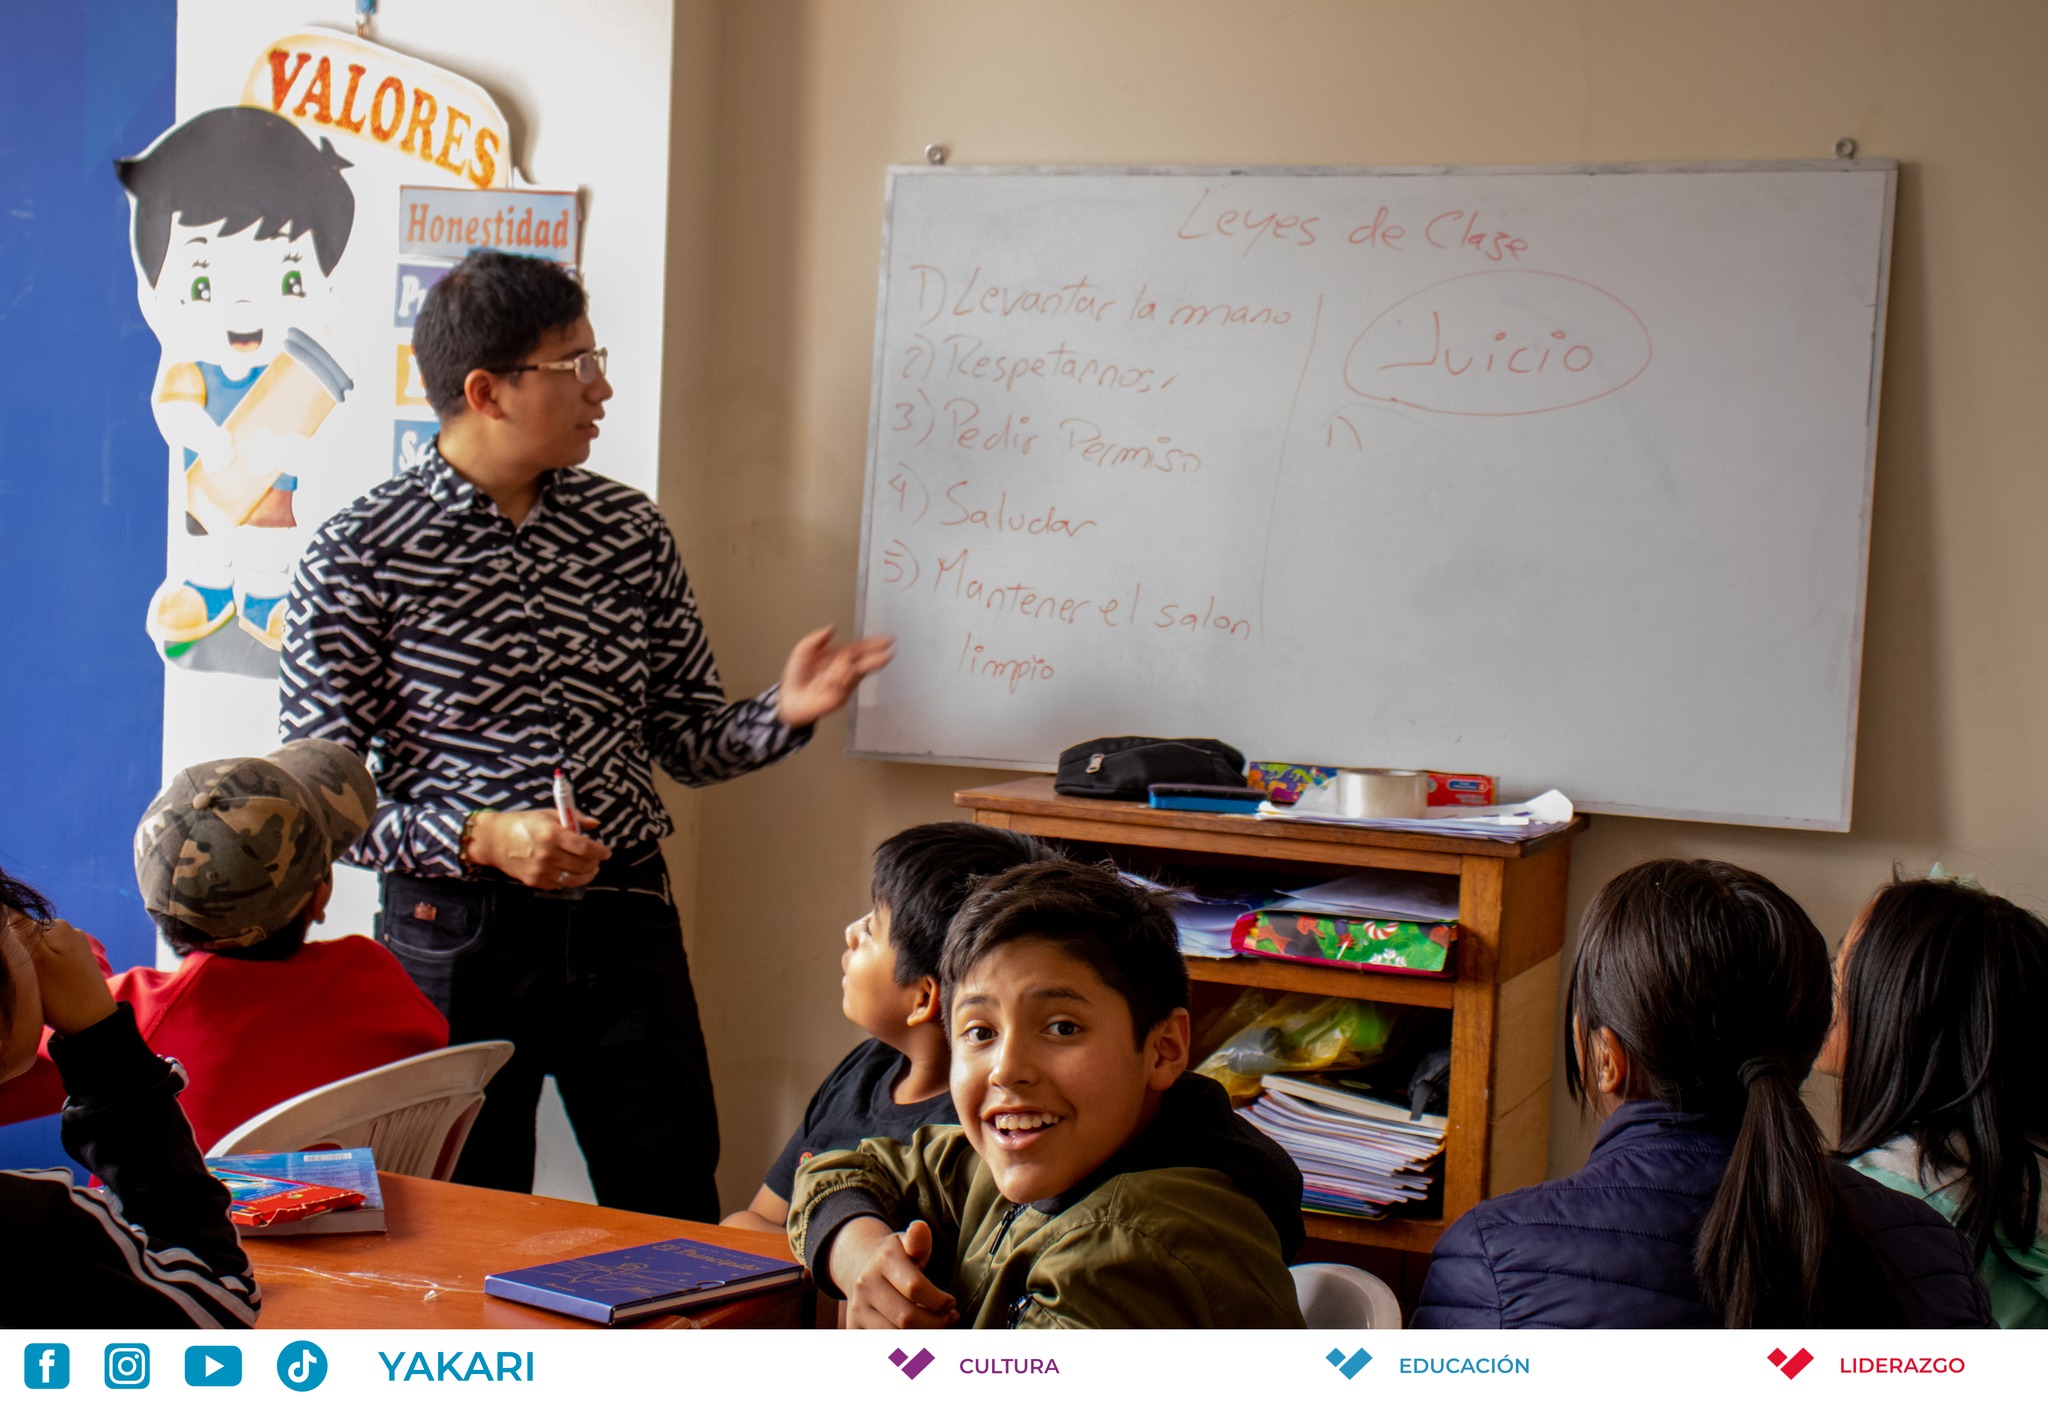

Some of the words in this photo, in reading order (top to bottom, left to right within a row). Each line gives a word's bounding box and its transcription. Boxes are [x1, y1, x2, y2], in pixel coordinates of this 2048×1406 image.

[268, 48, 500, 190] VALORES
[406, 203, 570, 249] Honestidad
[1177, 188, 1320, 256] Leyes
[1348, 206, 1406, 251] de
[953, 267, 1115, 322] Levantar
[1130, 283, 1156, 321] la
[1169, 301, 1292, 326] mano
[1379, 310, 1593, 376] Juicio
[943, 398, 1040, 454] Pedir
[940, 481, 1098, 538] Saludar
[933, 548, 1091, 625] Mantener
[1099, 583, 1141, 628] el
[1154, 596, 1252, 641] salon
[957, 632, 1055, 695] limpio
